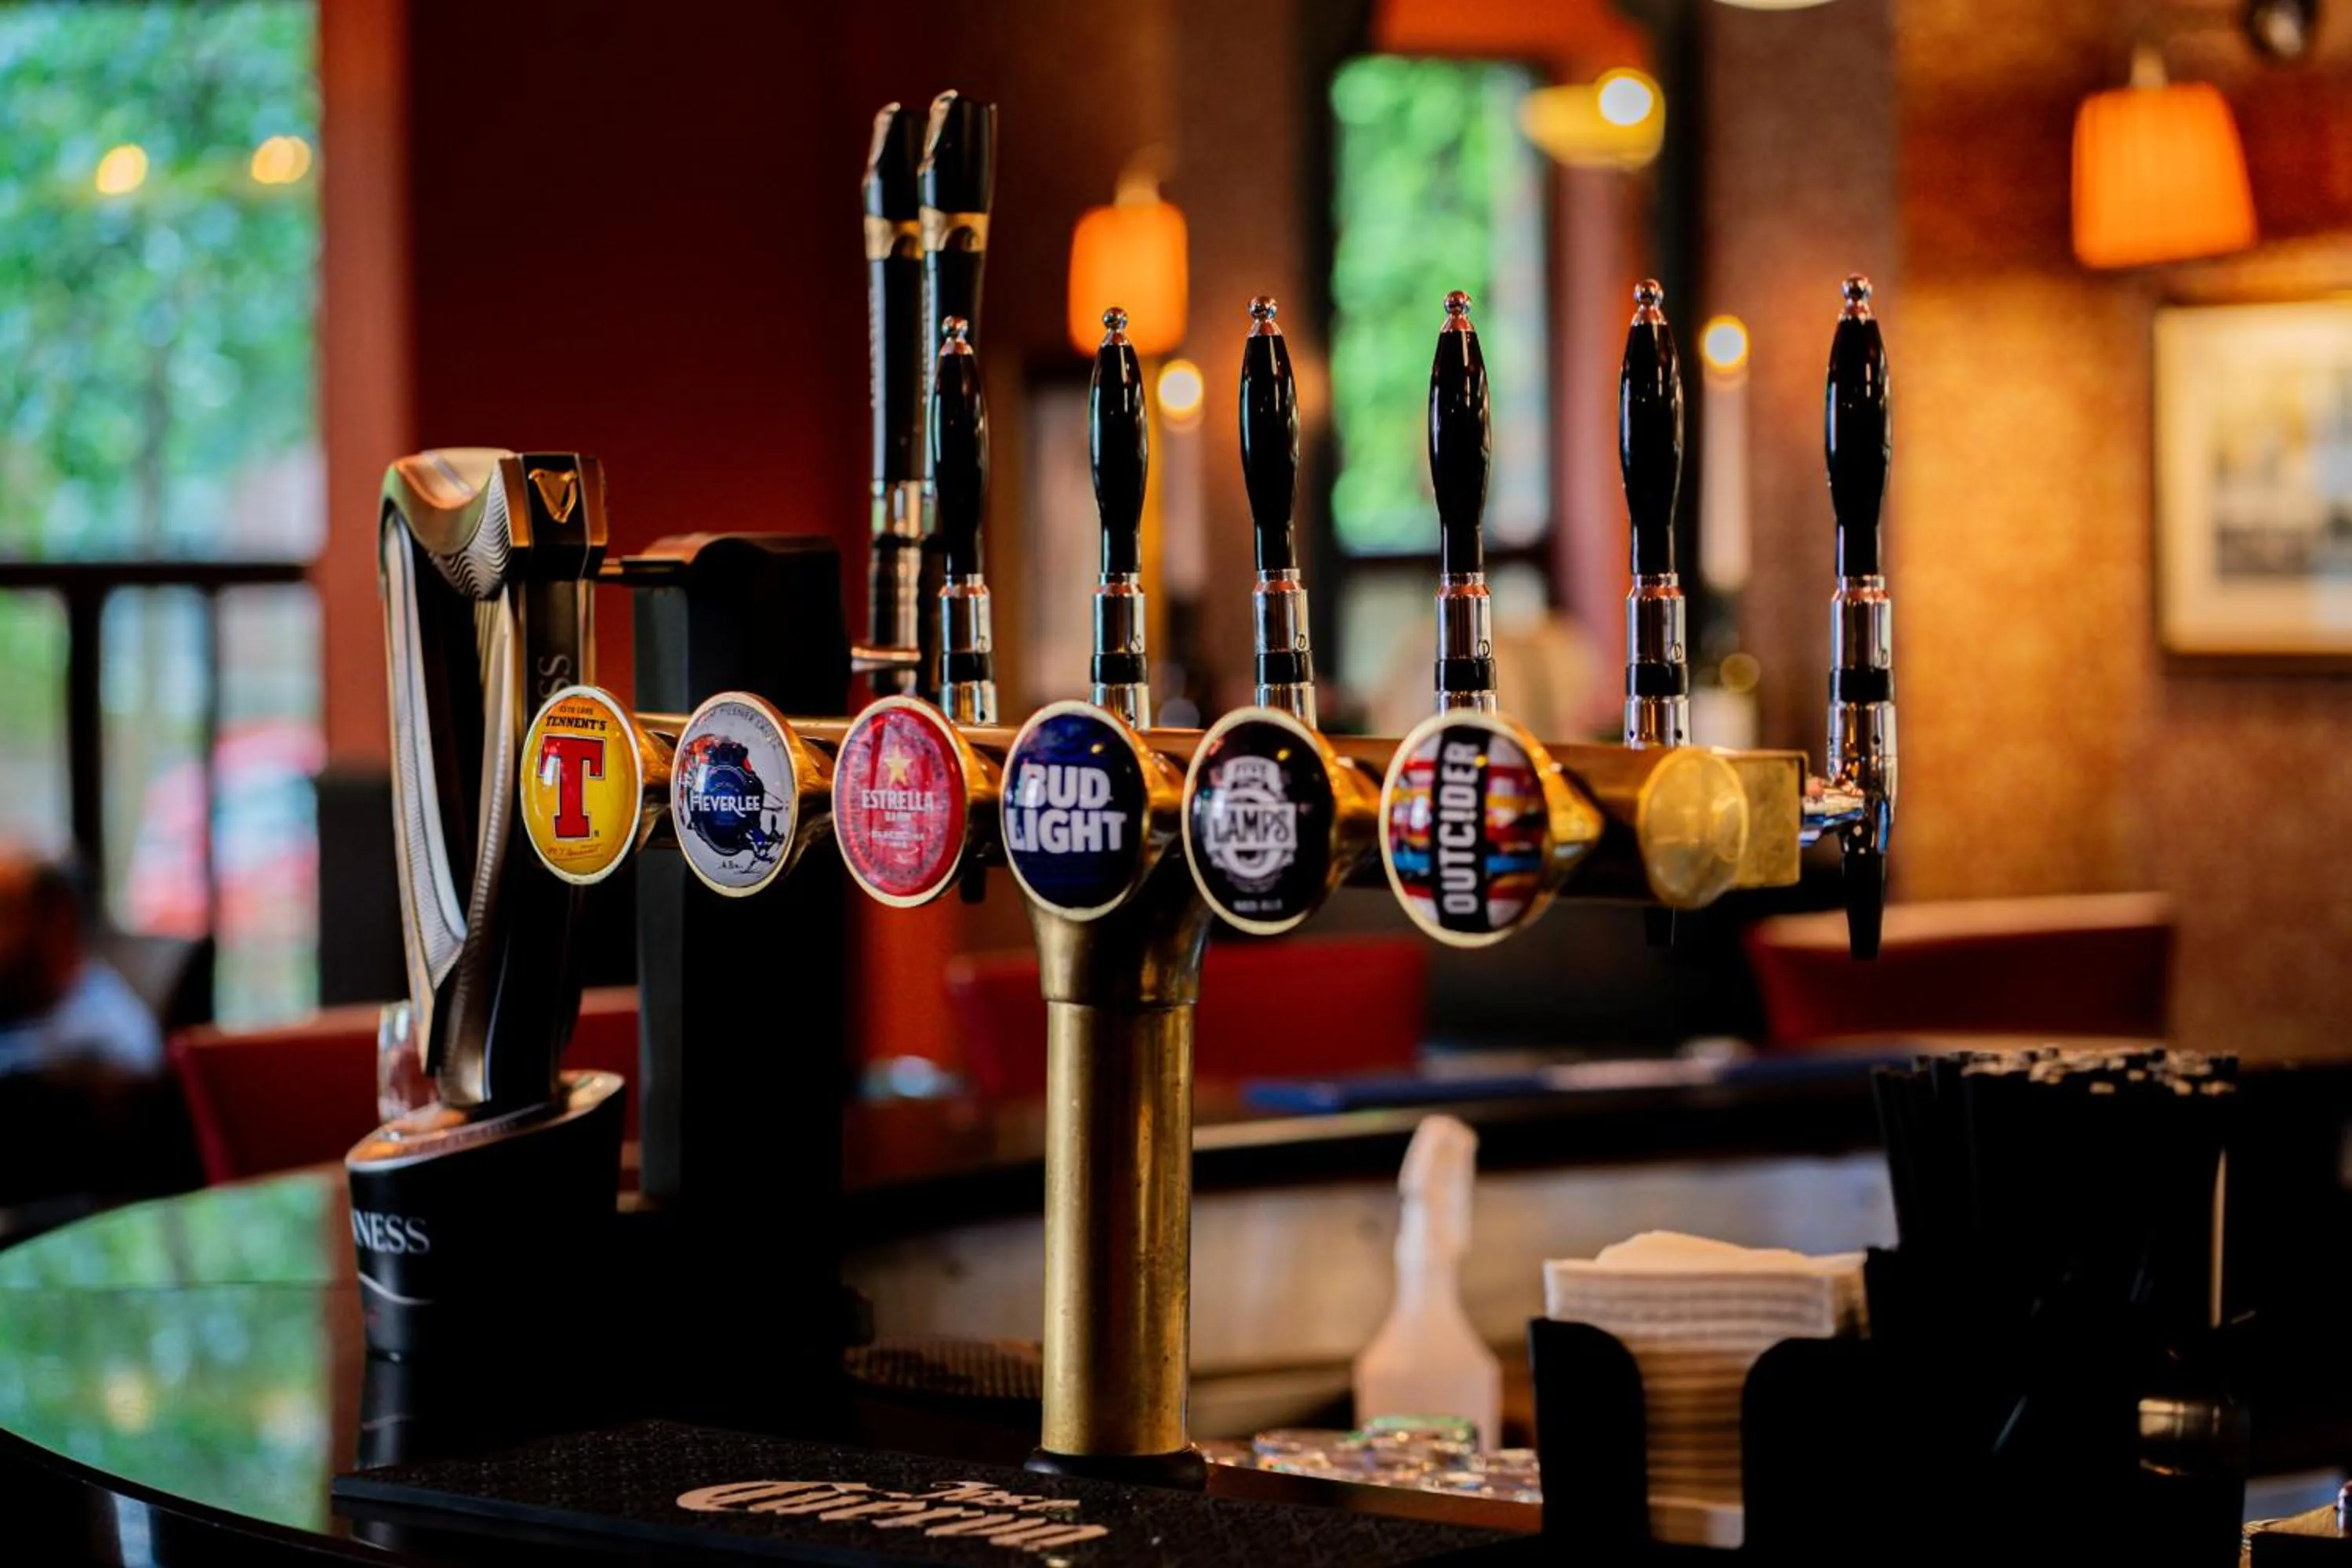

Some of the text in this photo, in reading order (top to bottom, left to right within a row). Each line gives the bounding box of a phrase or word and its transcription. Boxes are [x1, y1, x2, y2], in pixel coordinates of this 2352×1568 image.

[546, 714, 608, 731] TENNENT'S
[537, 733, 606, 840] T
[689, 790, 761, 818] HEVERLEE
[861, 789, 934, 813] ESTRELLA
[1015, 764, 1110, 809] BUD
[1007, 808, 1127, 854] LIGHT
[1213, 808, 1290, 844] LAMPS
